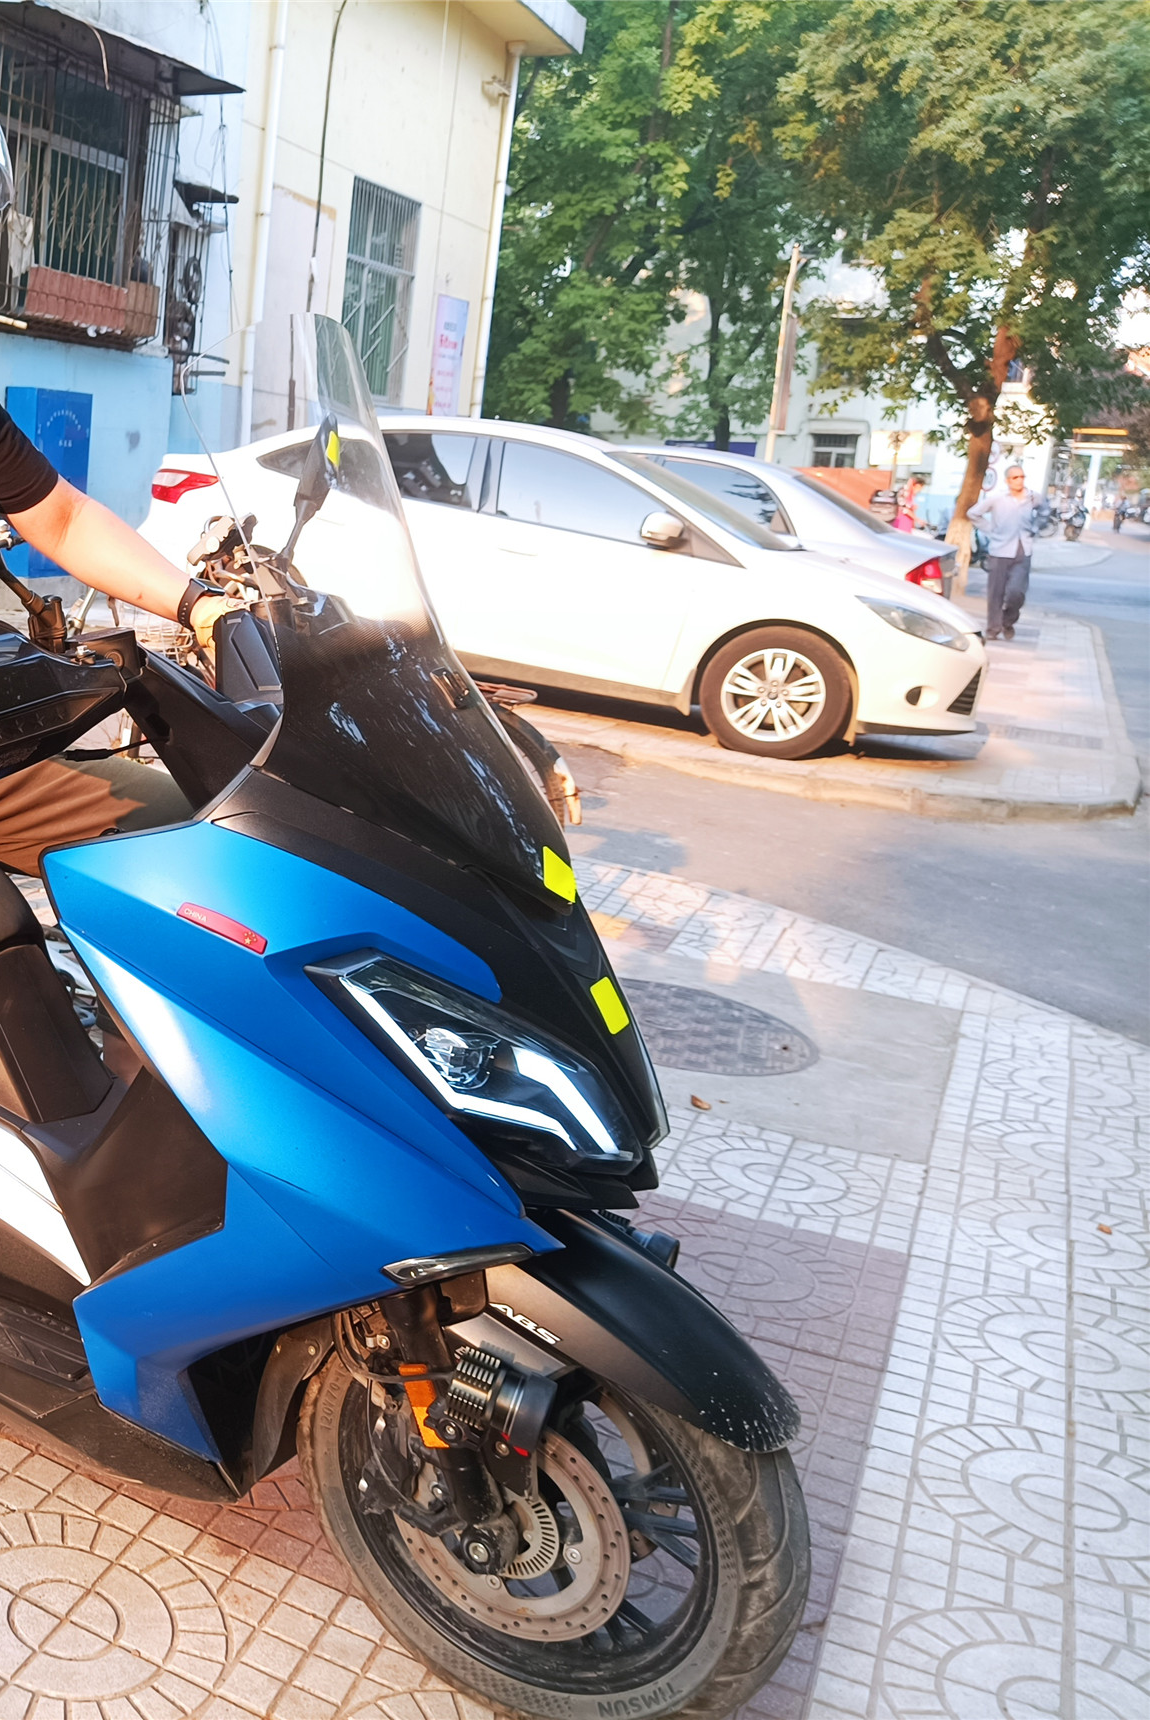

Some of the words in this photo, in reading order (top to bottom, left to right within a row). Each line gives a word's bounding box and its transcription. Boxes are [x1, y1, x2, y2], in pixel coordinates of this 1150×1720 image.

[183, 907, 207, 922] CHINA
[488, 1302, 563, 1345] ABS
[596, 1681, 684, 1718] TIMSUN
